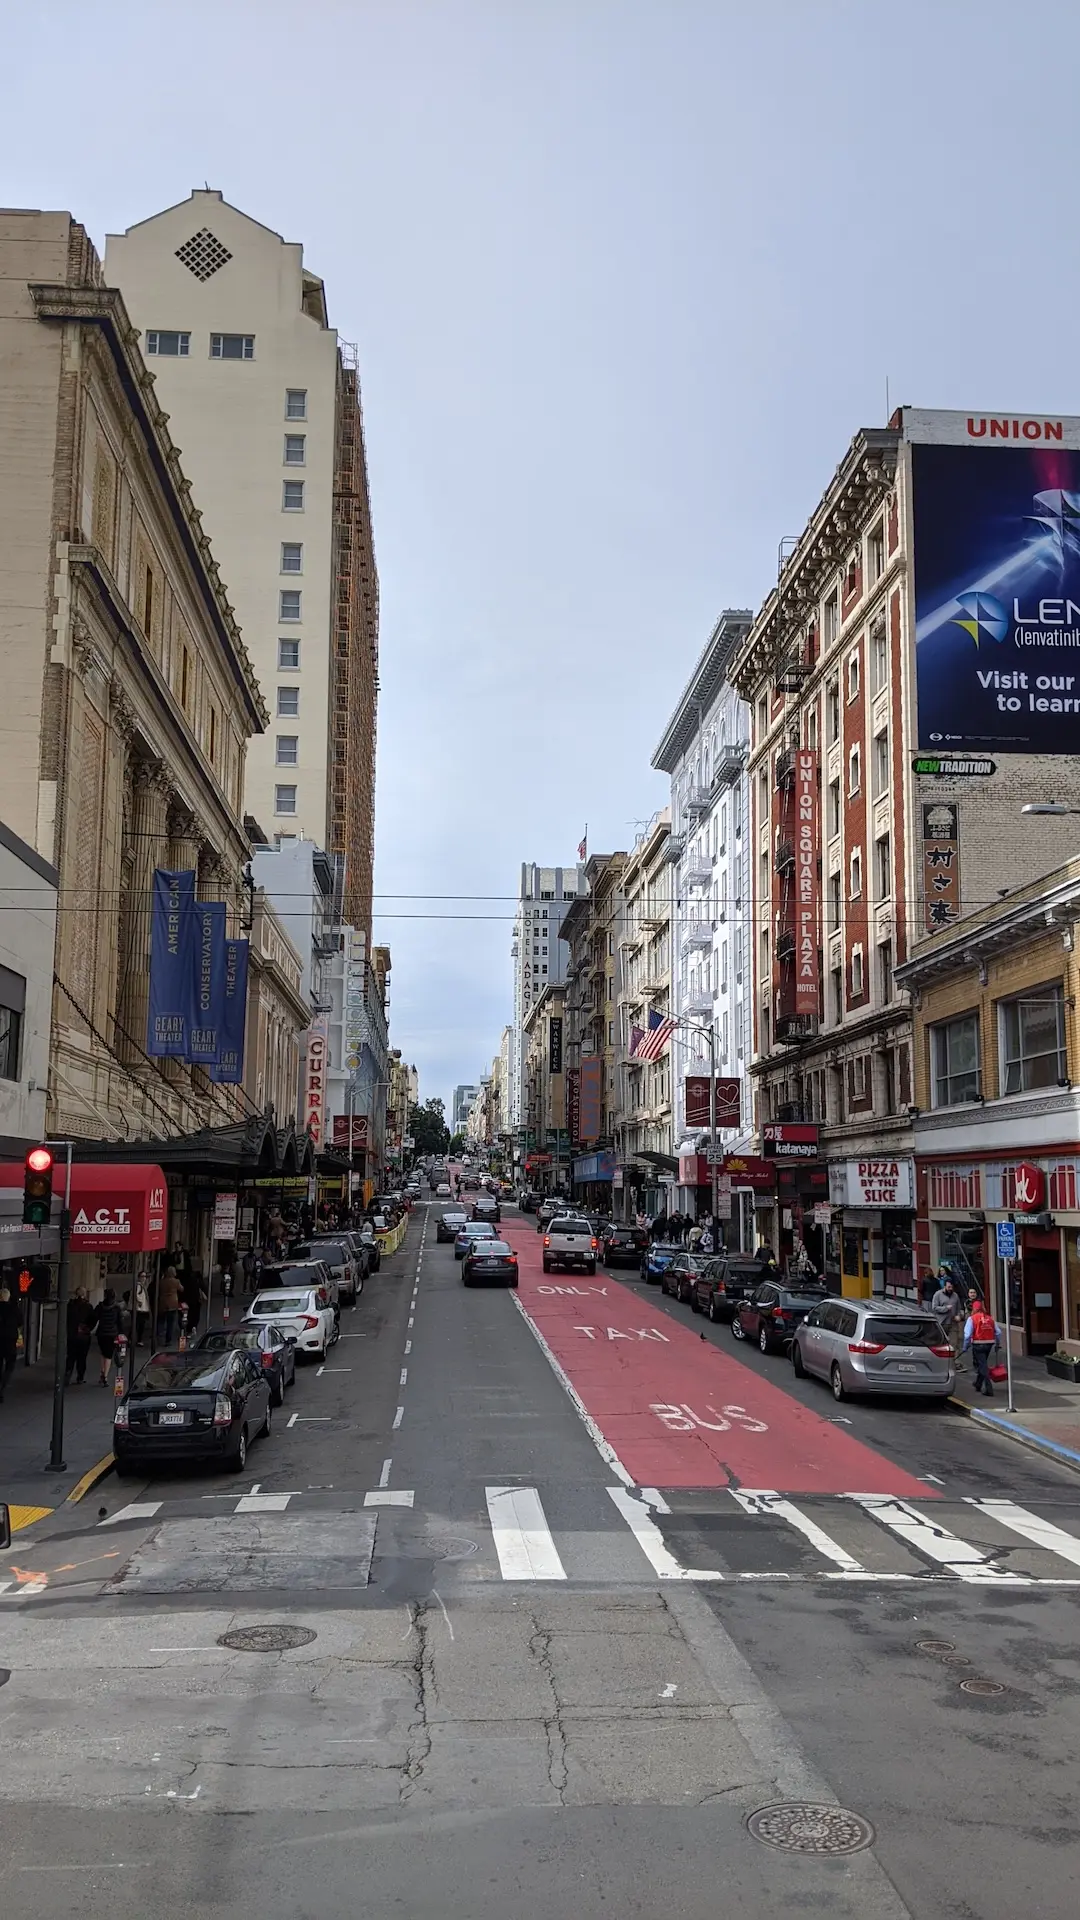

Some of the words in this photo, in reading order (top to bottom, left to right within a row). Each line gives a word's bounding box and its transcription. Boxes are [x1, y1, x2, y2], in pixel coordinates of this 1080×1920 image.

[967, 418, 1063, 441] UNION
[976, 670, 1029, 690] Visit
[1036, 675, 1075, 691] our
[996, 693, 1021, 712] to
[799, 755, 812, 820] UNION
[799, 825, 813, 904] SQUARE
[168, 879, 180, 955] AMERICAN
[800, 911, 813, 977] PLAZA
[200, 911, 213, 1011] CONSERVATORY
[227, 945, 237, 997] THEATER
[797, 983, 817, 993] HOTEL
[155, 1017, 185, 1031] GEARY
[156, 1032, 183, 1042] THEATER
[191, 1030, 216, 1044] GEARY
[191, 1043, 216, 1052] THEATER
[552, 1024, 560, 1069] WARWICK
[220, 1052, 238, 1064] EARY
[308, 1041, 323, 1143] CURRAN
[775, 1142, 817, 1156] katanaya
[708, 1154, 722, 1163] 25
[858, 1163, 899, 1177] PIZZA
[861, 1179, 874, 1187] BY
[877, 1179, 898, 1187] THE
[864, 1190, 896, 1202] SLICE
[74, 1208, 130, 1224] A.C.T.
[537, 1286, 607, 1295] ONLY
[573, 1327, 670, 1341] TAXI
[649, 1403, 768, 1431] BUS
